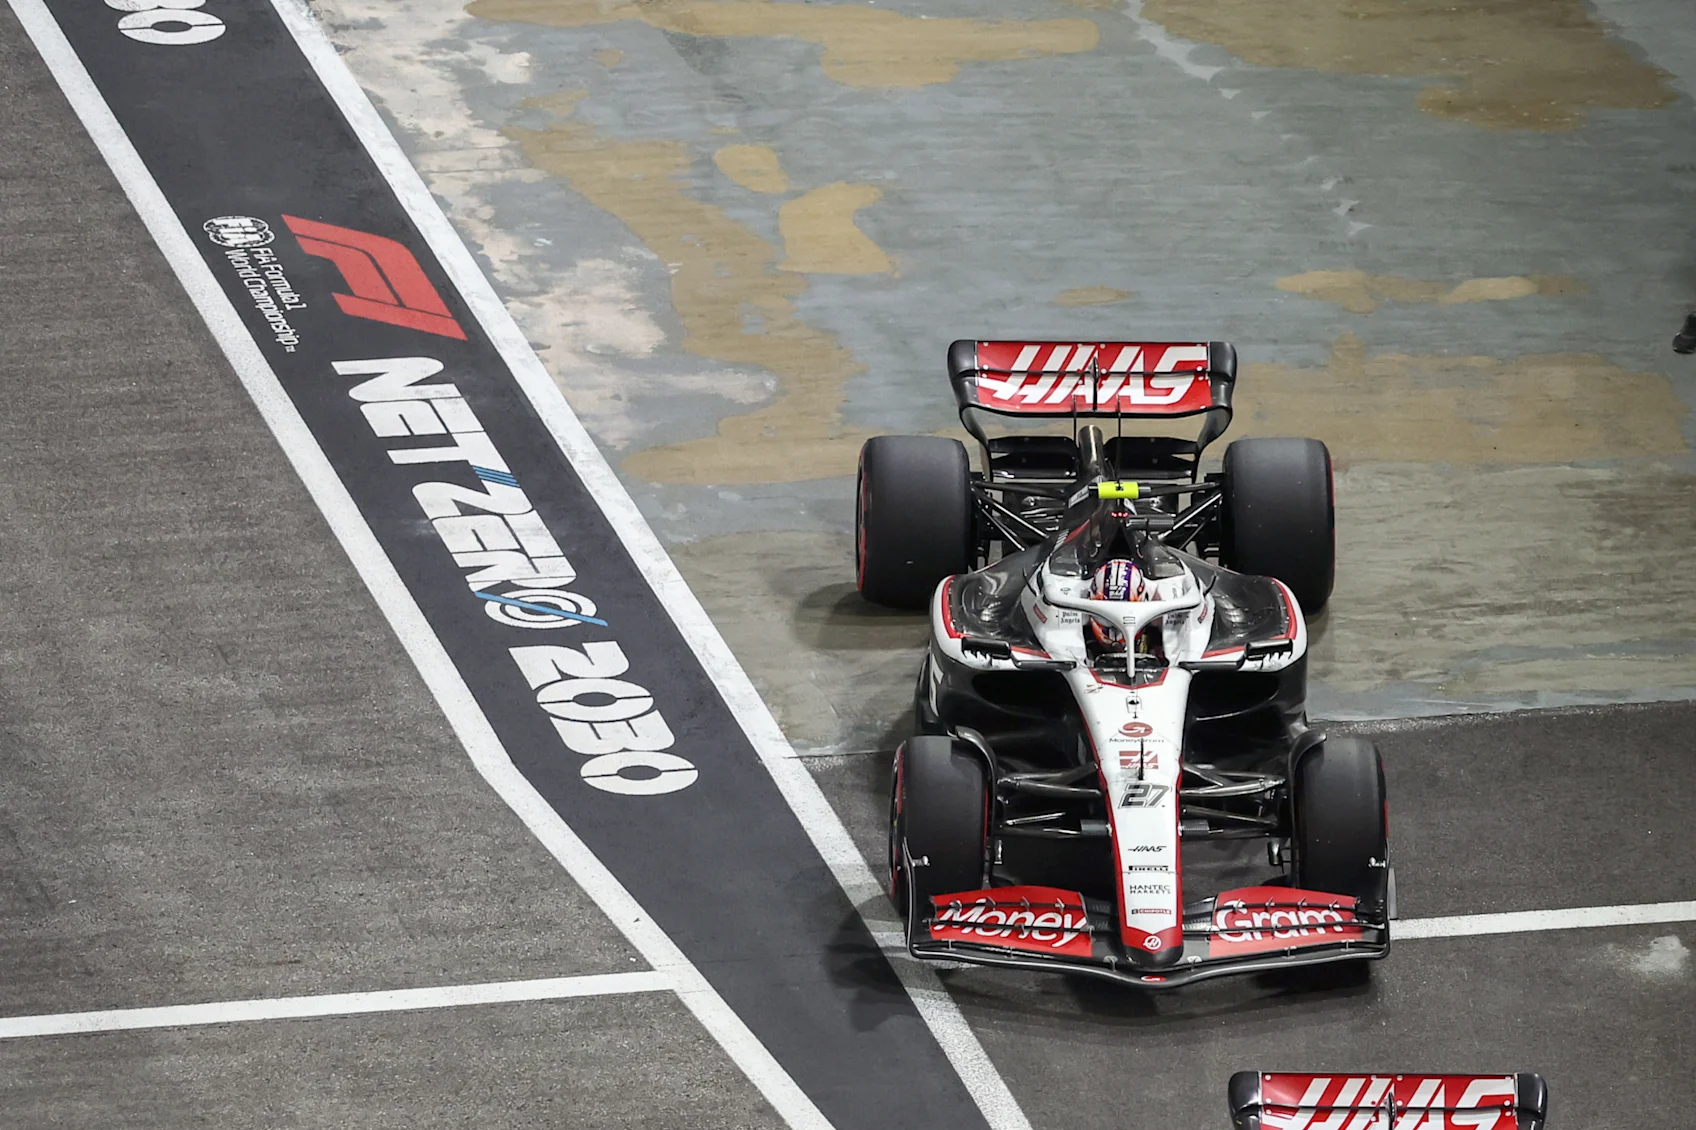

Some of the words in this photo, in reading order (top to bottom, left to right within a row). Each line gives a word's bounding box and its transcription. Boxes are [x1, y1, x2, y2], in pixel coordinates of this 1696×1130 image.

[225, 248, 262, 278] World
[249, 247, 277, 264] FIA
[260, 263, 301, 304] Formula
[284, 302, 308, 311] 1
[243, 277, 301, 345] Championship
[977, 345, 1208, 404] HAAS
[331, 356, 512, 476] NET
[411, 476, 604, 630] ZERO
[508, 640, 699, 796] 2030
[1118, 783, 1172, 809] 27
[934, 901, 1088, 948] Money
[1215, 899, 1345, 944] Gram
